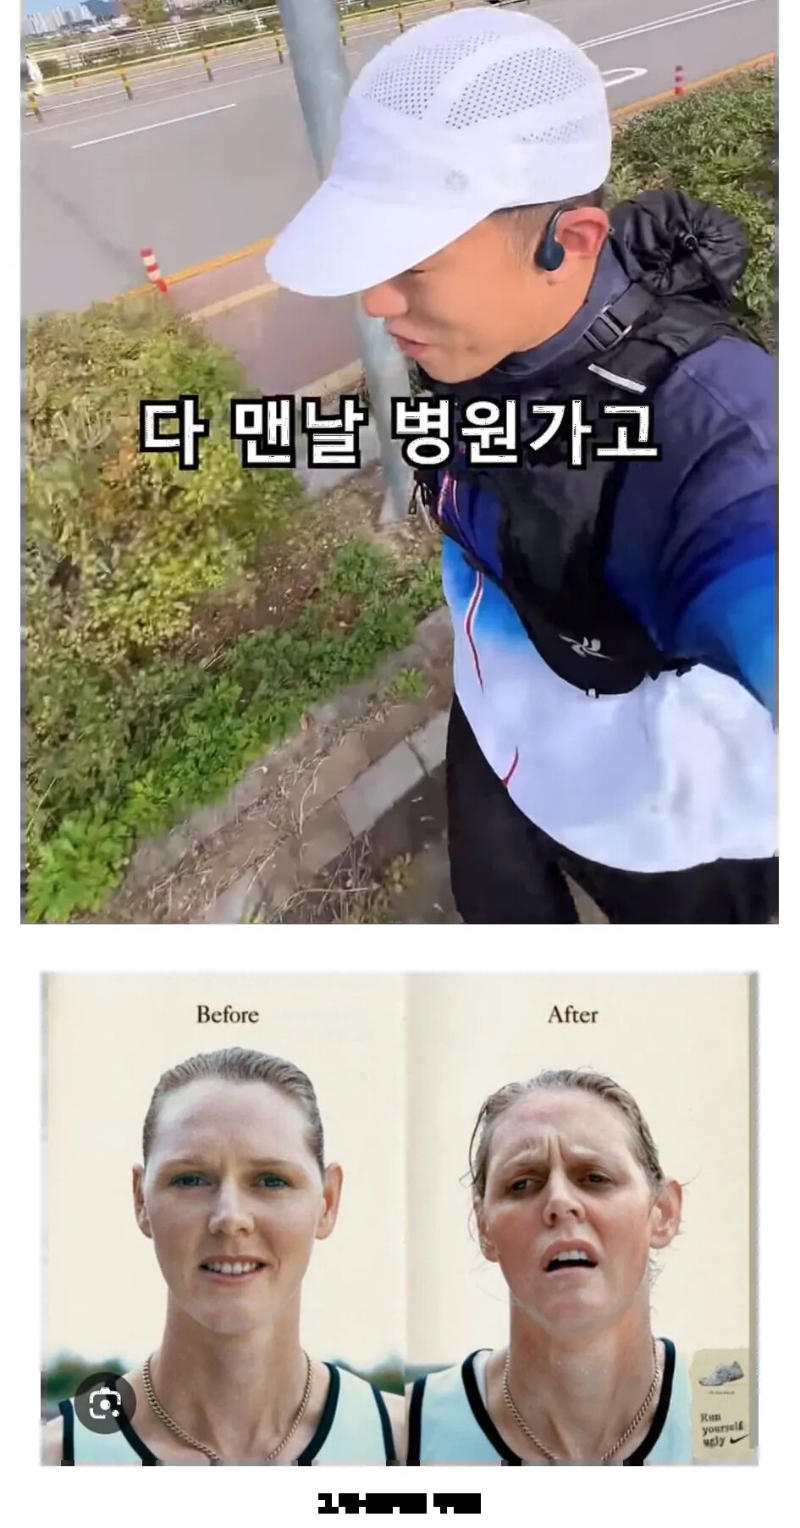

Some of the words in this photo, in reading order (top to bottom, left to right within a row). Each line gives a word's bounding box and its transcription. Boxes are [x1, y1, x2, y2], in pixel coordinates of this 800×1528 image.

[198, 1006, 258, 1023] Before
[549, 1006, 598, 1023] After
[700, 1413, 721, 1423] Run
[702, 1421, 744, 1436] yourself
[703, 1436, 725, 1448] ugly
